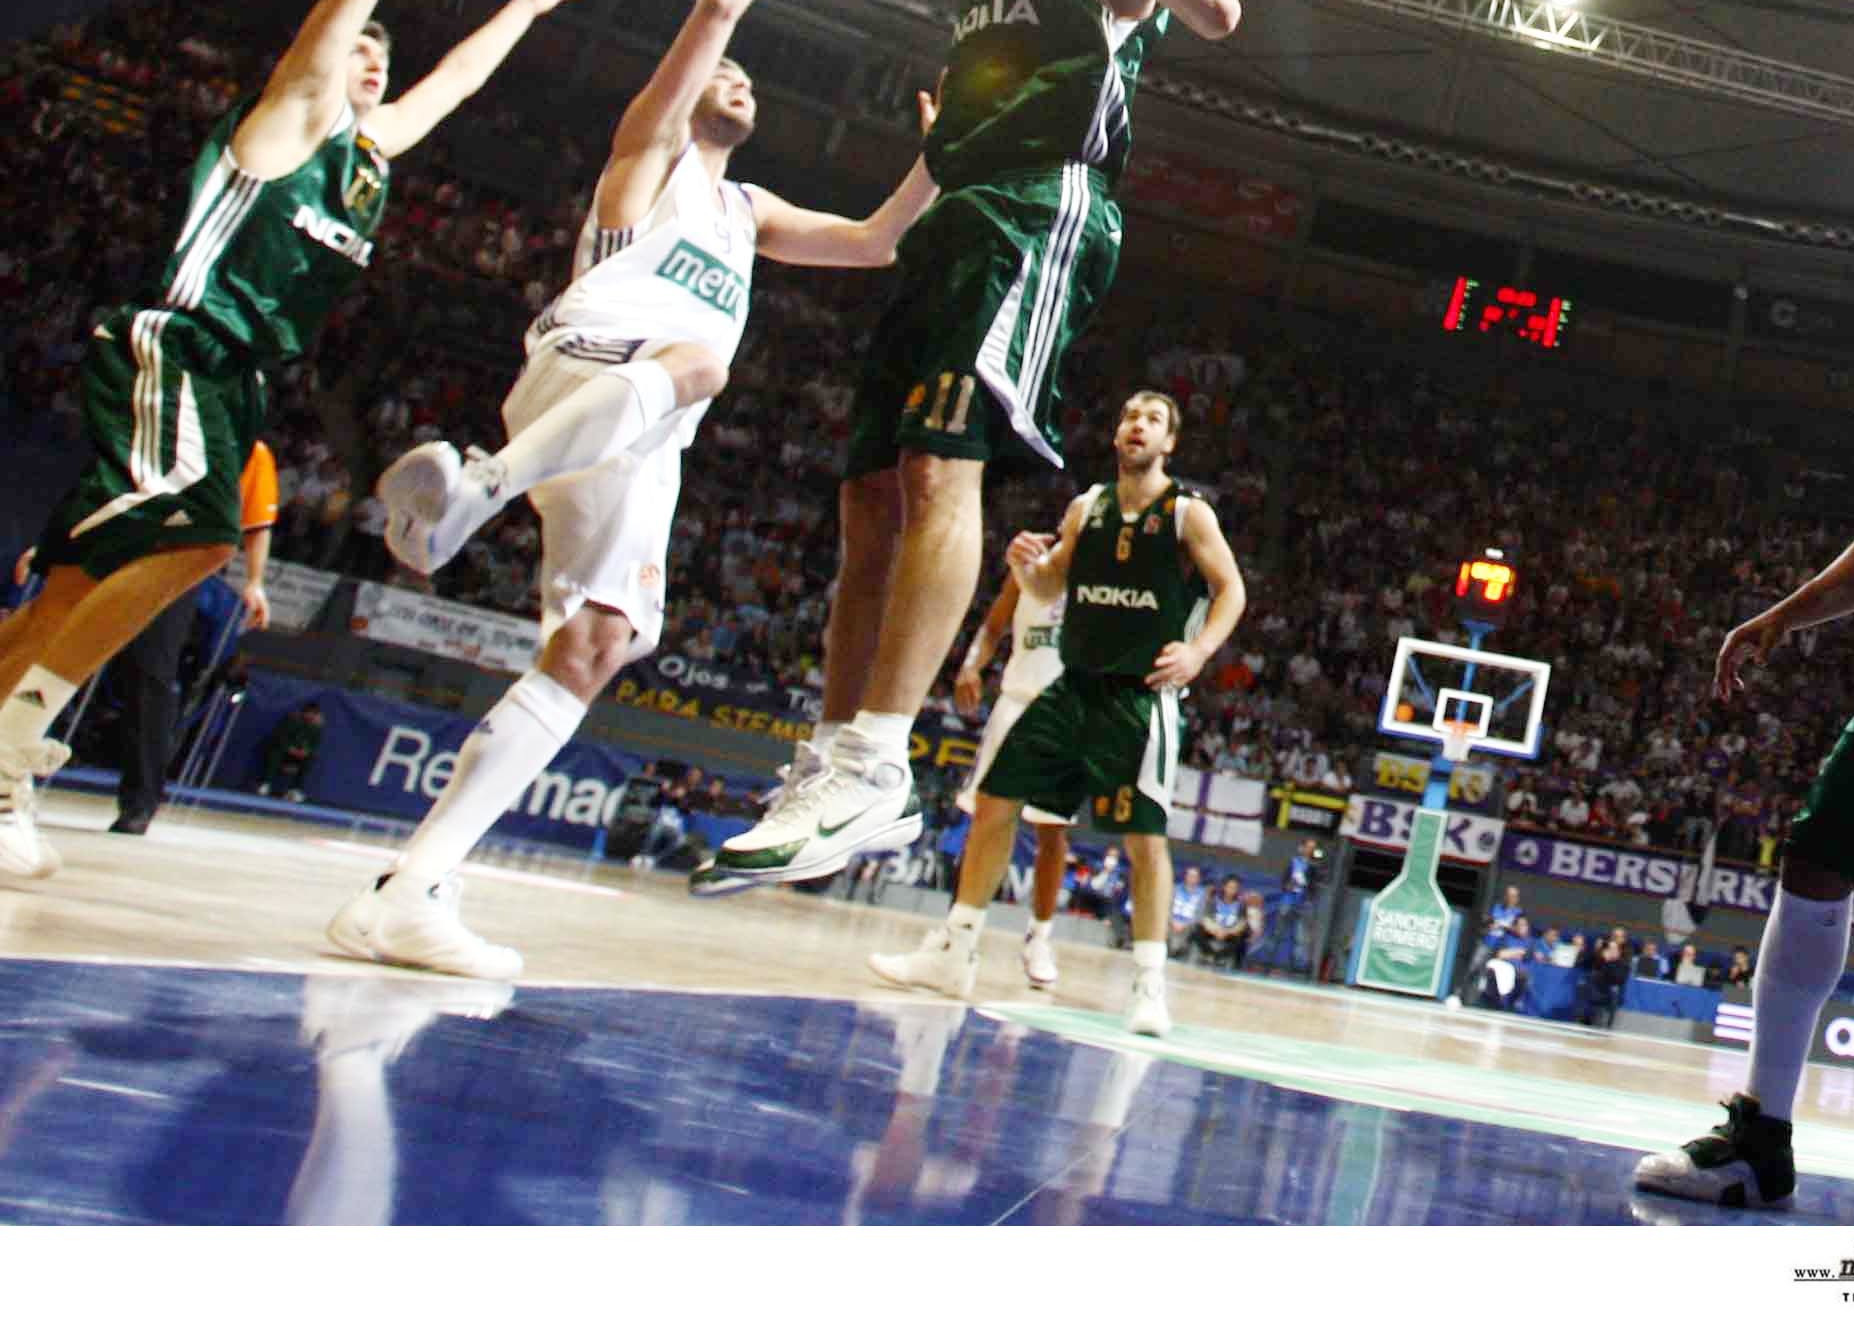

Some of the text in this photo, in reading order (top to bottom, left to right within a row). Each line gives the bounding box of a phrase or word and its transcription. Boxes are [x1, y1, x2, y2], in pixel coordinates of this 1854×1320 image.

[924, 371, 975, 433] 11
[1116, 525, 1134, 562] 6
[1076, 584, 1160, 611] NOKIA
